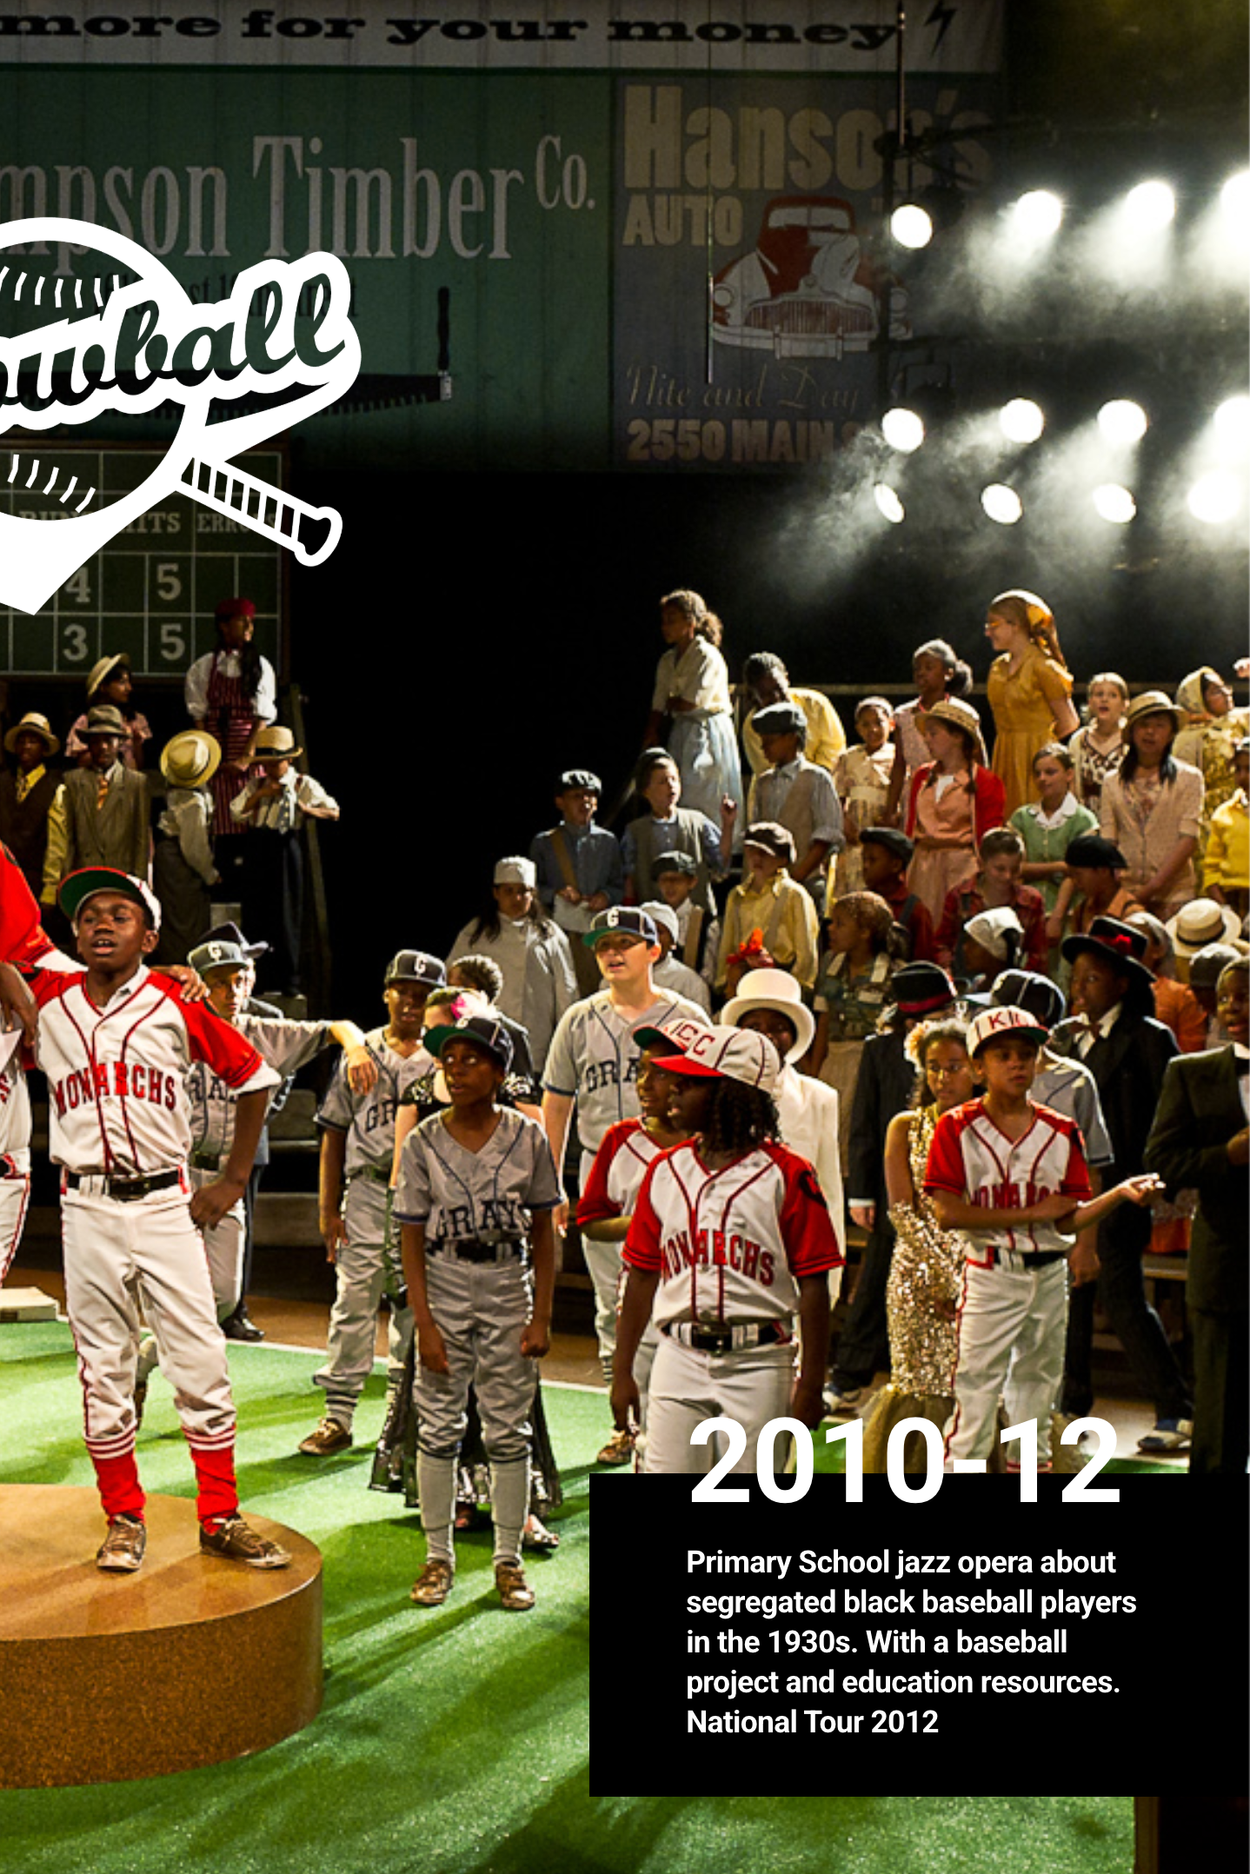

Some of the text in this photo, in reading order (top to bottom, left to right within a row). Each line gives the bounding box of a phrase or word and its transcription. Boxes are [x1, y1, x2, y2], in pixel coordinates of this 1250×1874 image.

[241, 10, 365, 38] for
[387, 19, 588, 45] your
[608, 20, 897, 49] money
[252, 134, 525, 260] Timber
[534, 134, 596, 210] Co.
[621, 194, 744, 247] AUTO
[703, 363, 770, 409] and
[626, 418, 727, 463] 2550
[731, 418, 835, 464] MAIN
[64, 566, 92, 603] 4
[156, 562, 182, 600] 5
[62, 623, 89, 661] 3
[160, 622, 186, 660] 5
[413, 956, 426, 975] G
[54, 1060, 176, 1121] MONARCHS
[585, 1058, 638, 1094] GRA
[660, 1228, 775, 1288] MONARCHS
